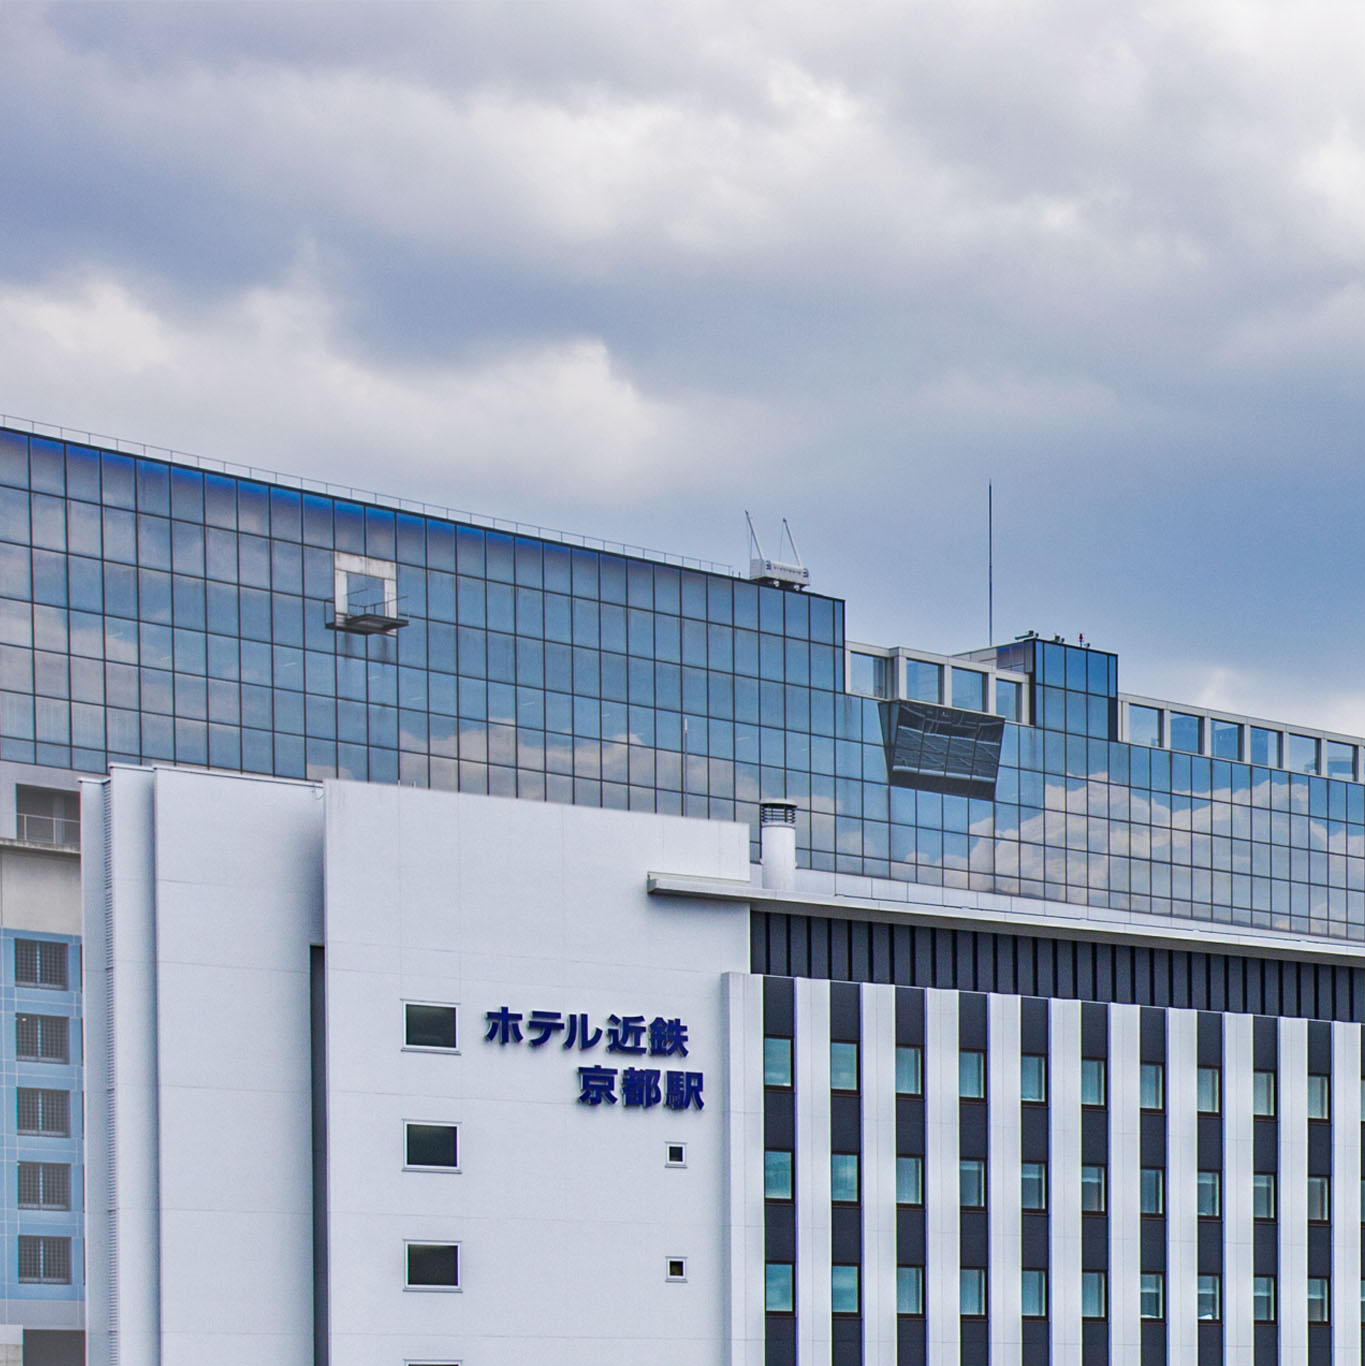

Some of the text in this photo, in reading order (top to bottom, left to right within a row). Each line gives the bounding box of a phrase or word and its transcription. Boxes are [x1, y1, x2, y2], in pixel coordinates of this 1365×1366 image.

[485, 1006, 689, 1057] ホテル近鉄
[577, 1064, 704, 1110] 京都駅
